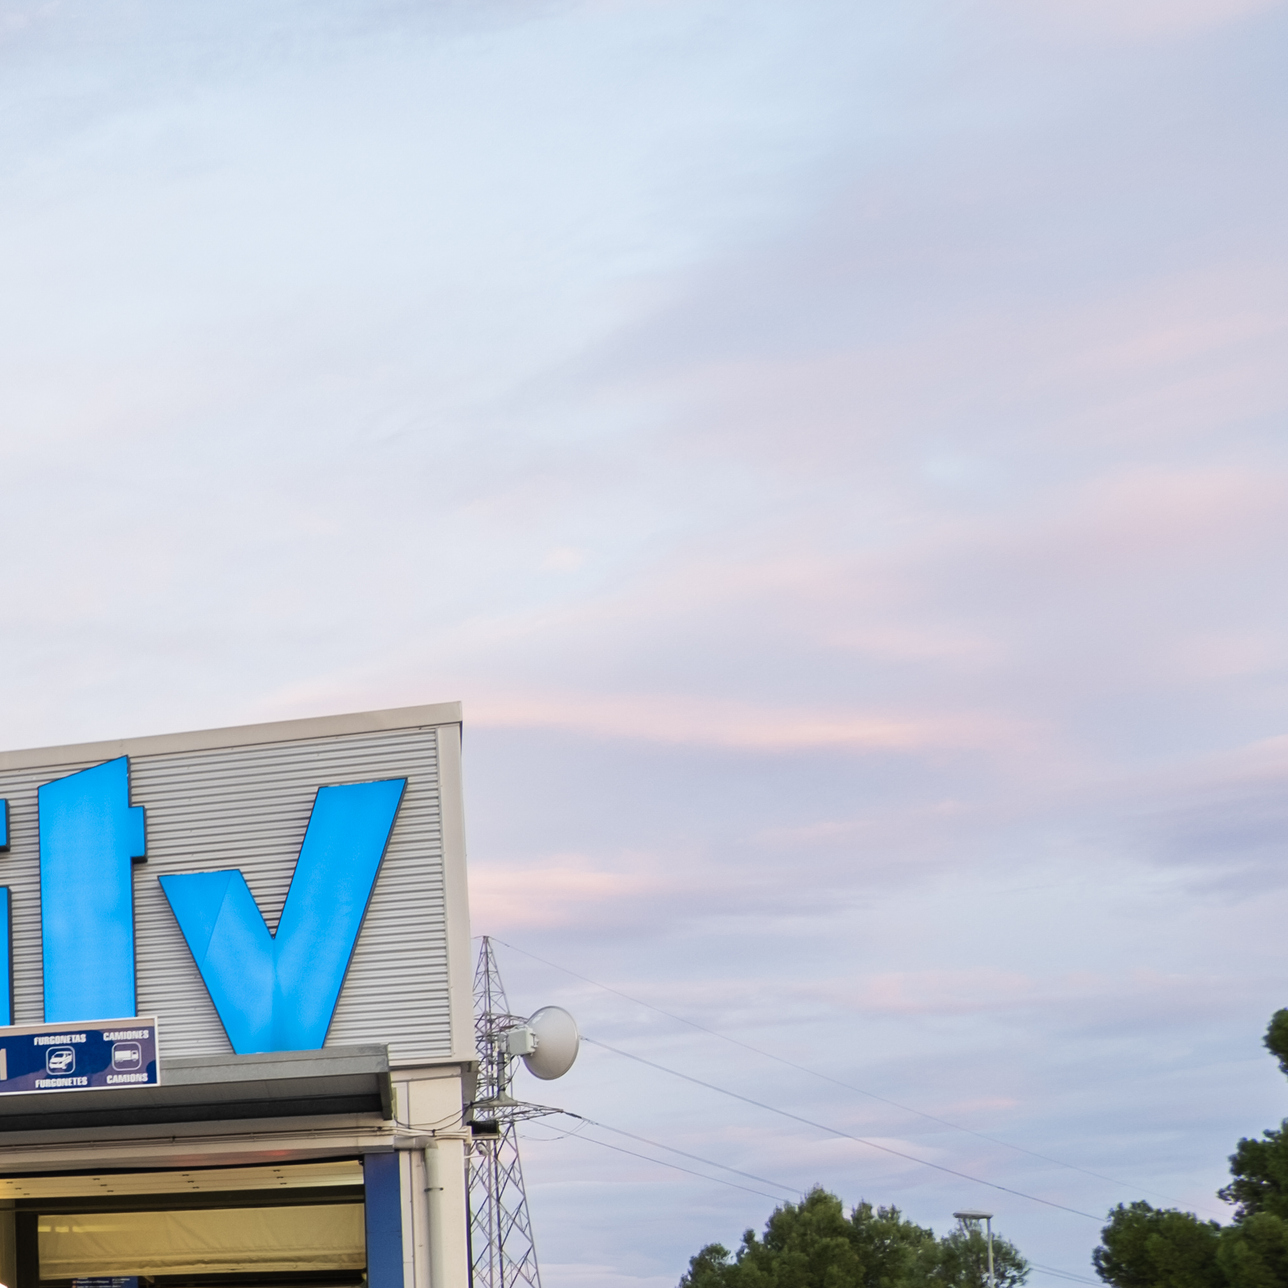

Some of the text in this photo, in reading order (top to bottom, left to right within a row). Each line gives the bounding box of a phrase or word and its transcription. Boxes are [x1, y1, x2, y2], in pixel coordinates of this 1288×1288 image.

[34, 1034, 87, 1046] FURGONETAS
[103, 1029, 149, 1041] CAMIONES
[35, 1077, 88, 1088] FURGONETES
[106, 1073, 148, 1084] CAMIONS
